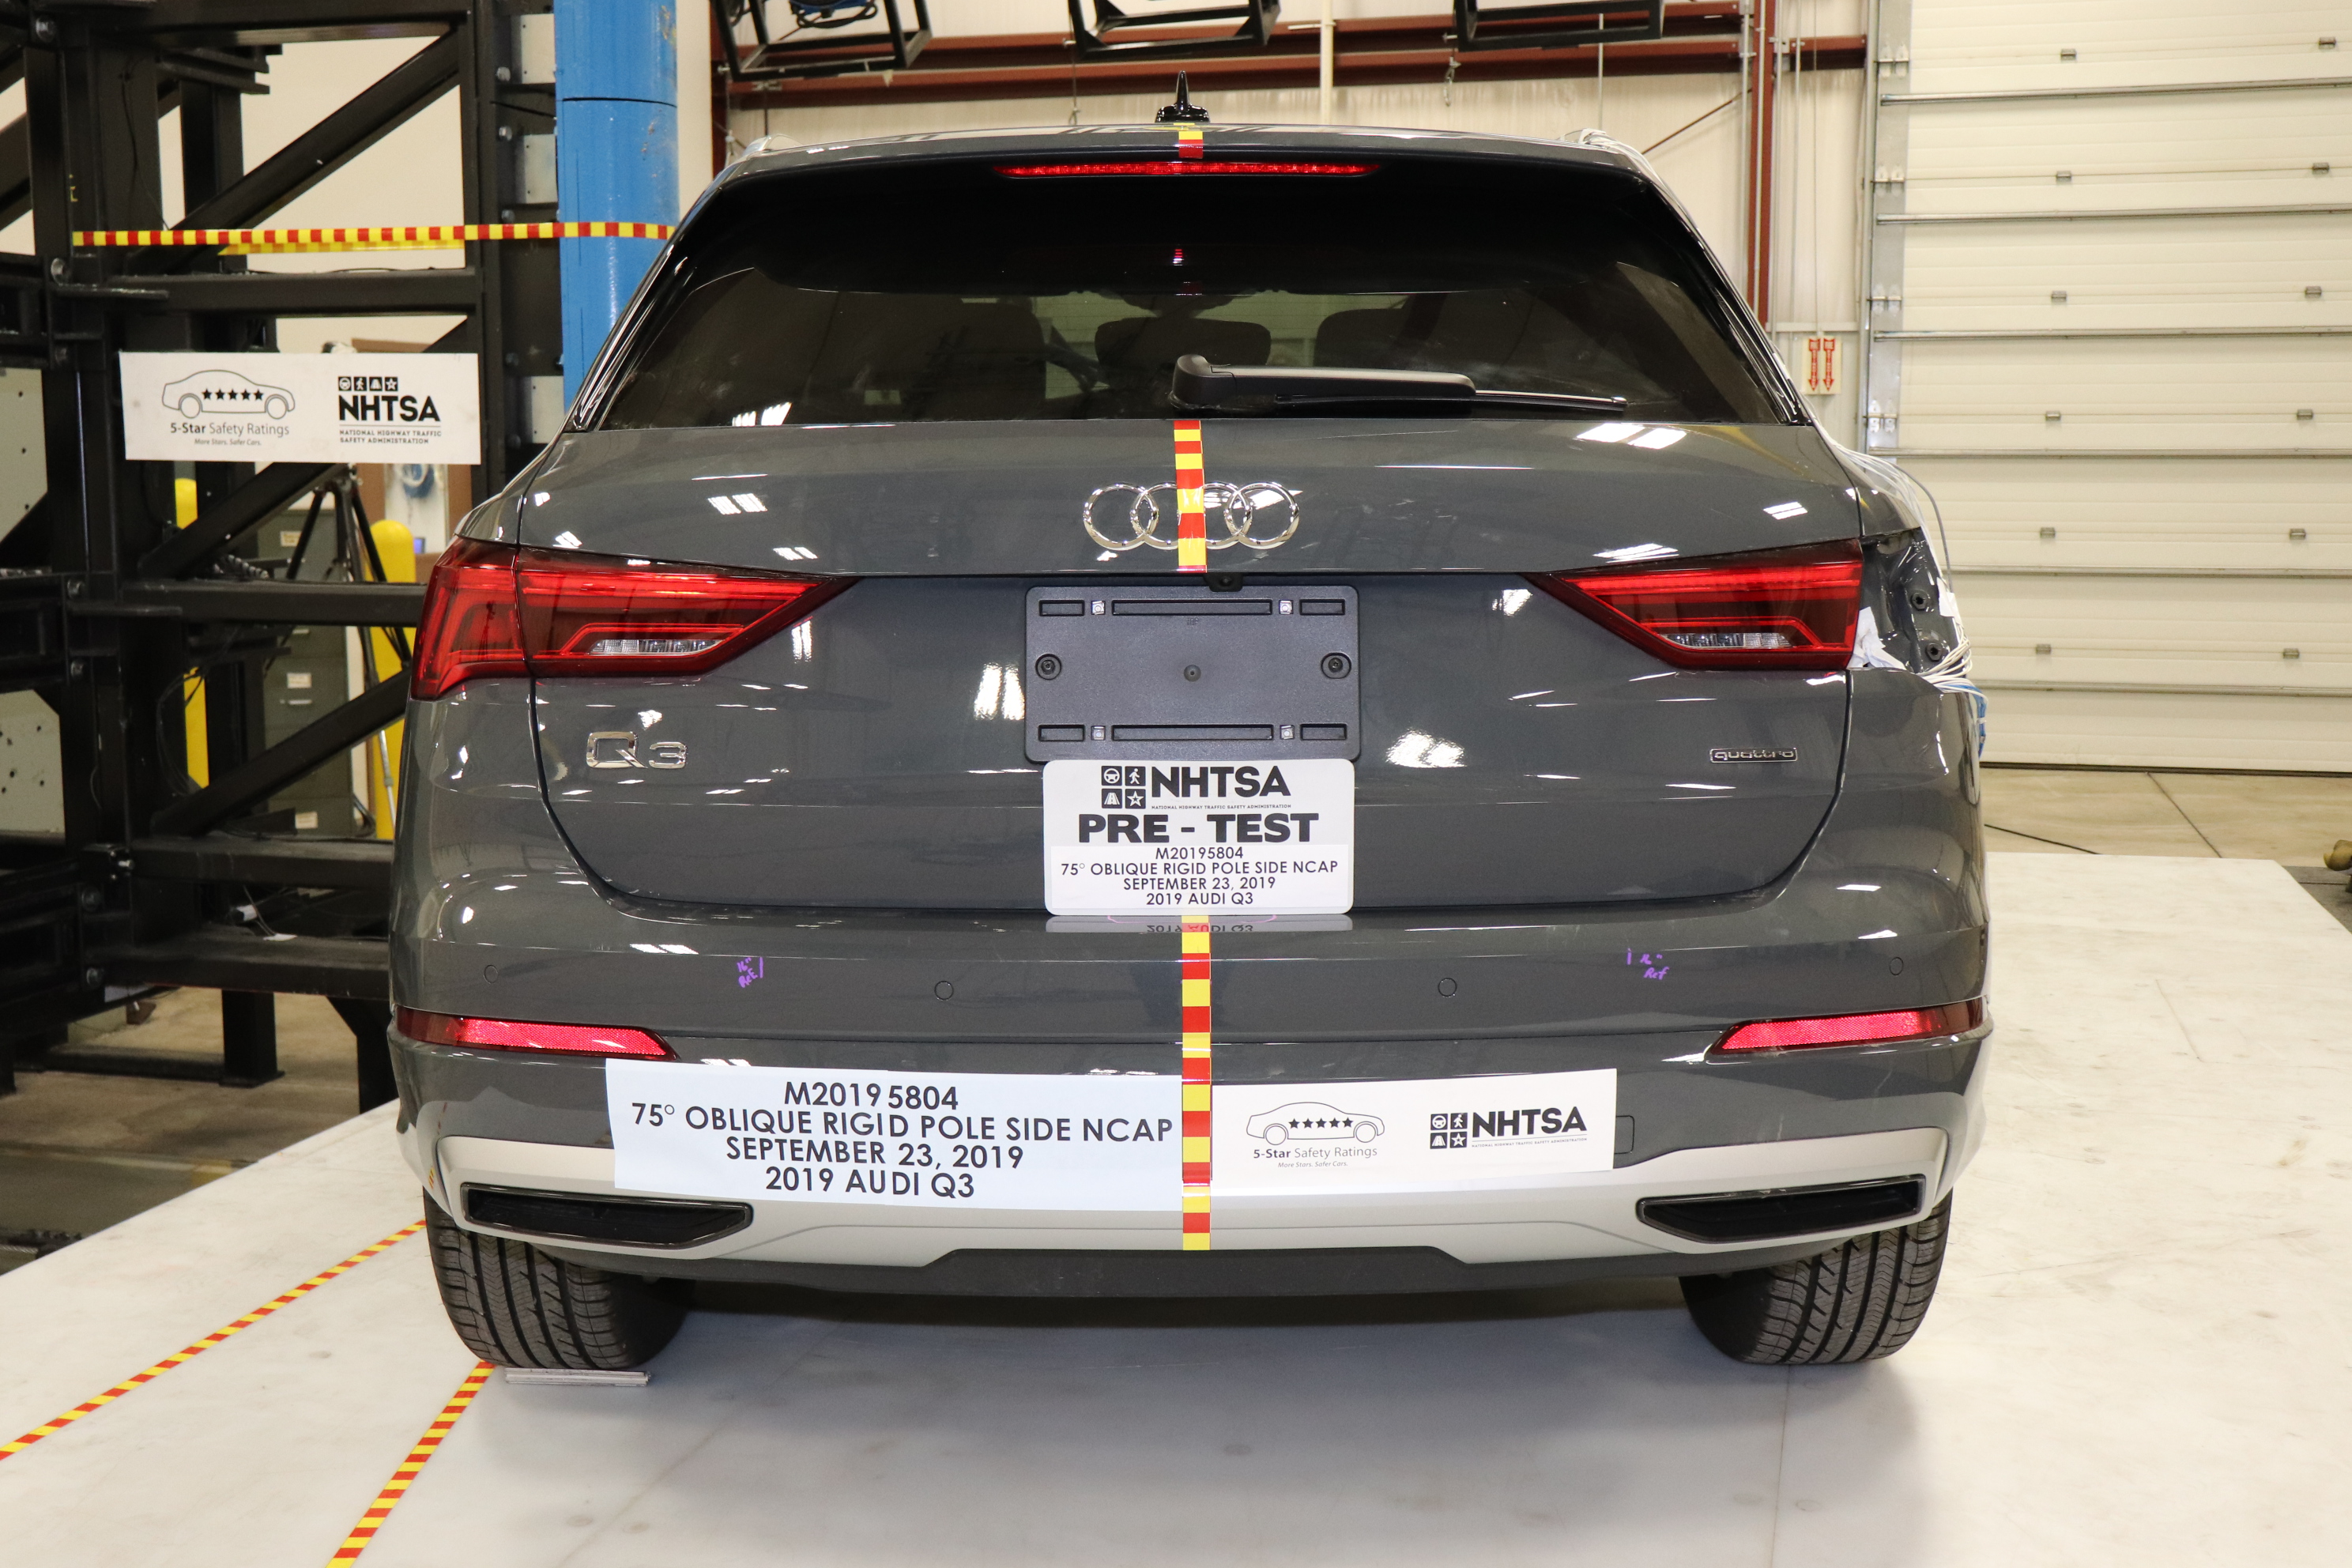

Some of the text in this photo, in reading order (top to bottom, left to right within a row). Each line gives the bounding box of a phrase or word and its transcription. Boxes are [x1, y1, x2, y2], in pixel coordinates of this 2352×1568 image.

[338, 394, 441, 422] NHTSA
[170, 421, 290, 439] 5-Star Safety Ratings
[586, 731, 687, 769] Q3
[1714, 749, 1795, 761] quattro
[1151, 765, 1291, 798] NHTSA
[1078, 813, 1170, 843] PRE
[1206, 812, 1320, 843] TEST
[1155, 846, 1244, 860] M20195804
[1090, 862, 1158, 876] OBLIQUE
[1163, 862, 1206, 875] RIGID
[1212, 861, 1250, 875] POLE
[1254, 861, 1287, 874] SIDE
[1293, 860, 1338, 873] NCAP
[1123, 876, 1276, 892] SEPTEMBER 23, 2019
[1146, 891, 1253, 906] 2019 AUDI Q3
[685, 1106, 812, 1135] OBLIQUE
[824, 1111, 909, 1137] RIGID
[921, 1115, 995, 1140] POLE
[1005, 1117, 1071, 1141] SIDE
[1083, 1118, 1173, 1142] NCAP
[1472, 1106, 1588, 1138] NHTSA
[726, 1136, 1023, 1170] SEPTEMBER 23, 2019
[1253, 1146, 1378, 1160] 5-Star Safety Ratings
[766, 1166, 974, 1199] 2019 AUDI Q3
